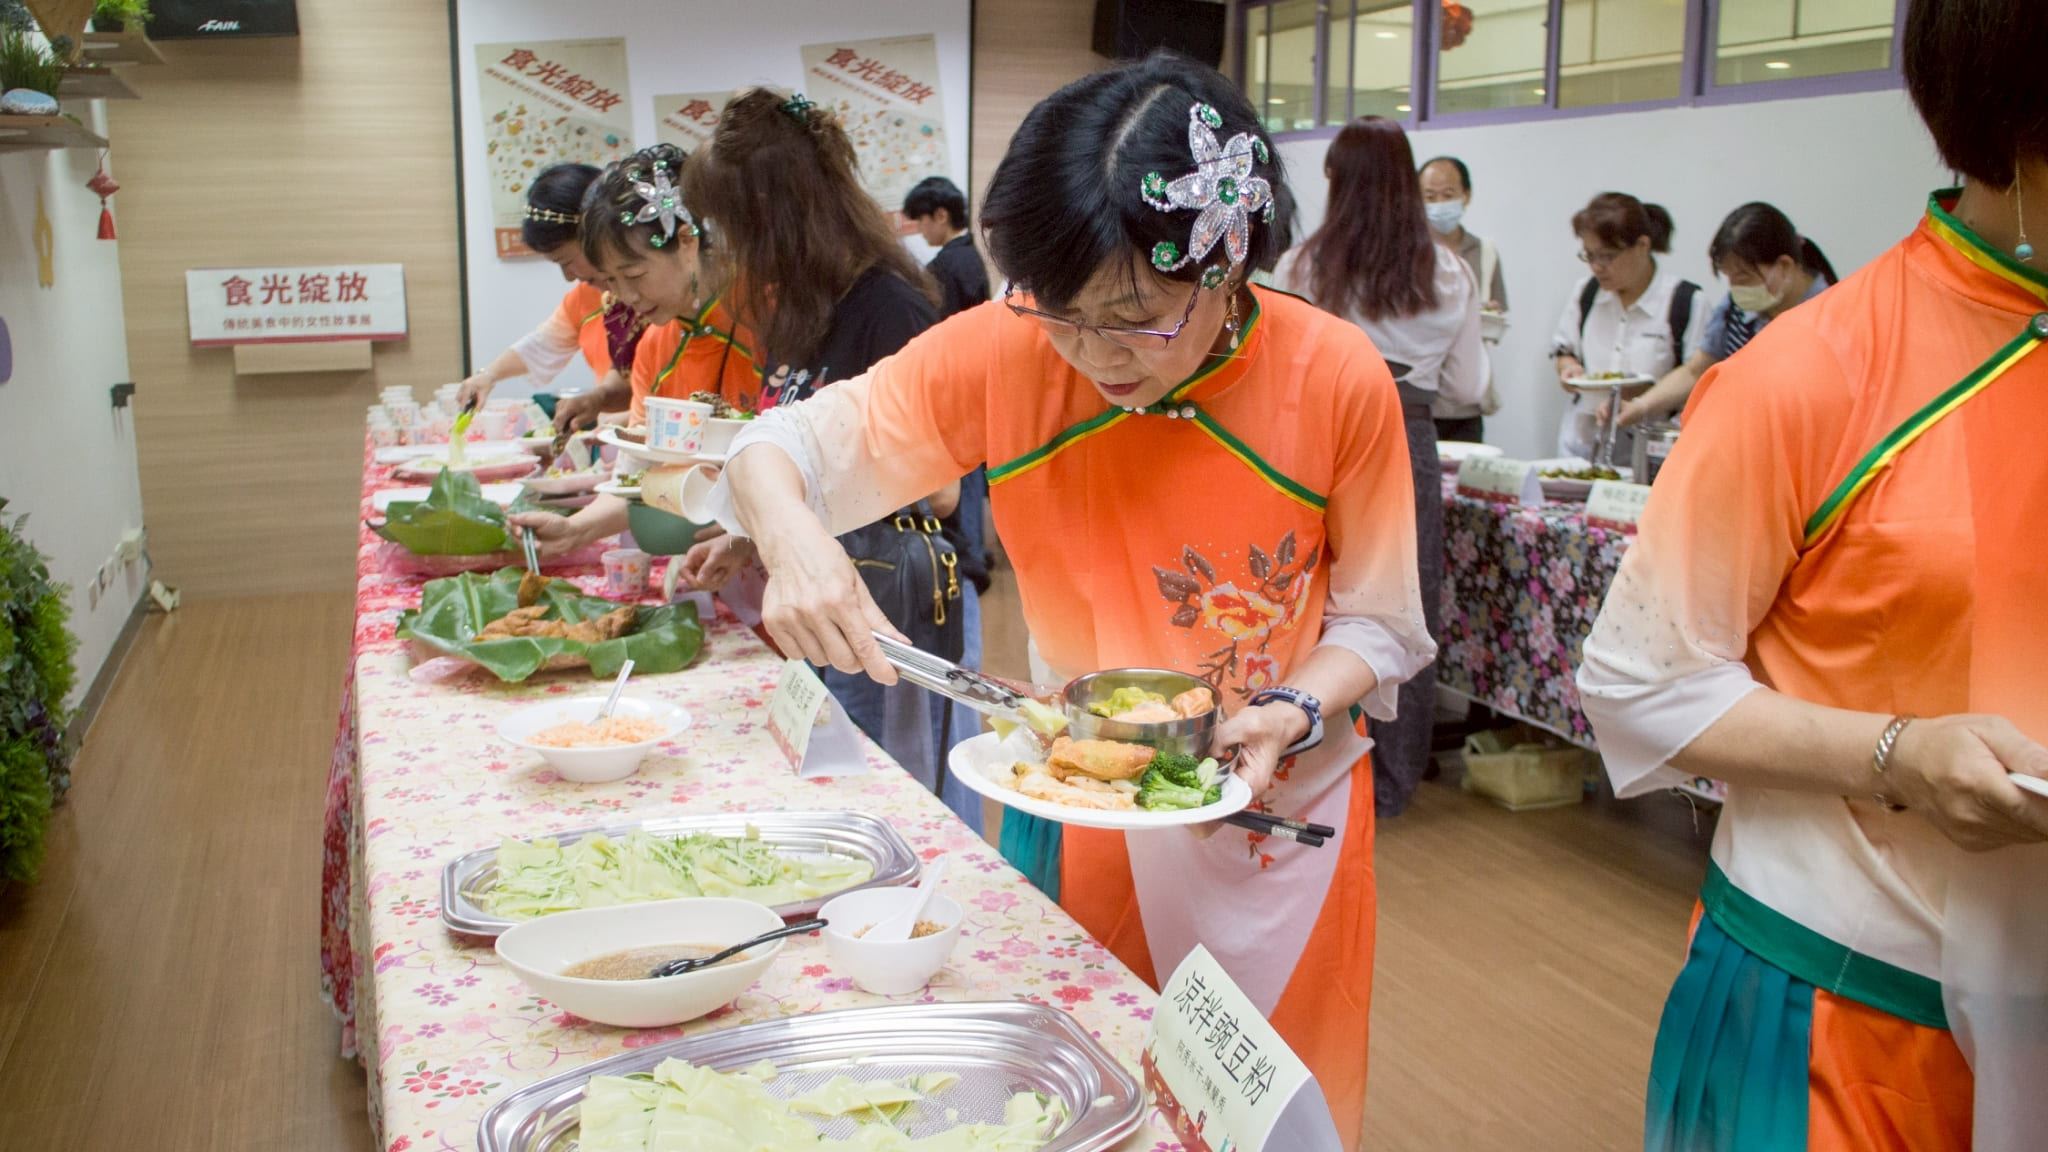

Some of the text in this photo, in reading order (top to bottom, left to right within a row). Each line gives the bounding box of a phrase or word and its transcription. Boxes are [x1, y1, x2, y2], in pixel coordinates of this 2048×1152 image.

[197, 19, 240, 32] FAIN
[501, 47, 623, 114] 食光綻放
[824, 46, 936, 105] 食光綻放
[221, 271, 369, 307] 食光綻放
[1173, 970, 1277, 1106] 涼拌豌豆粉
